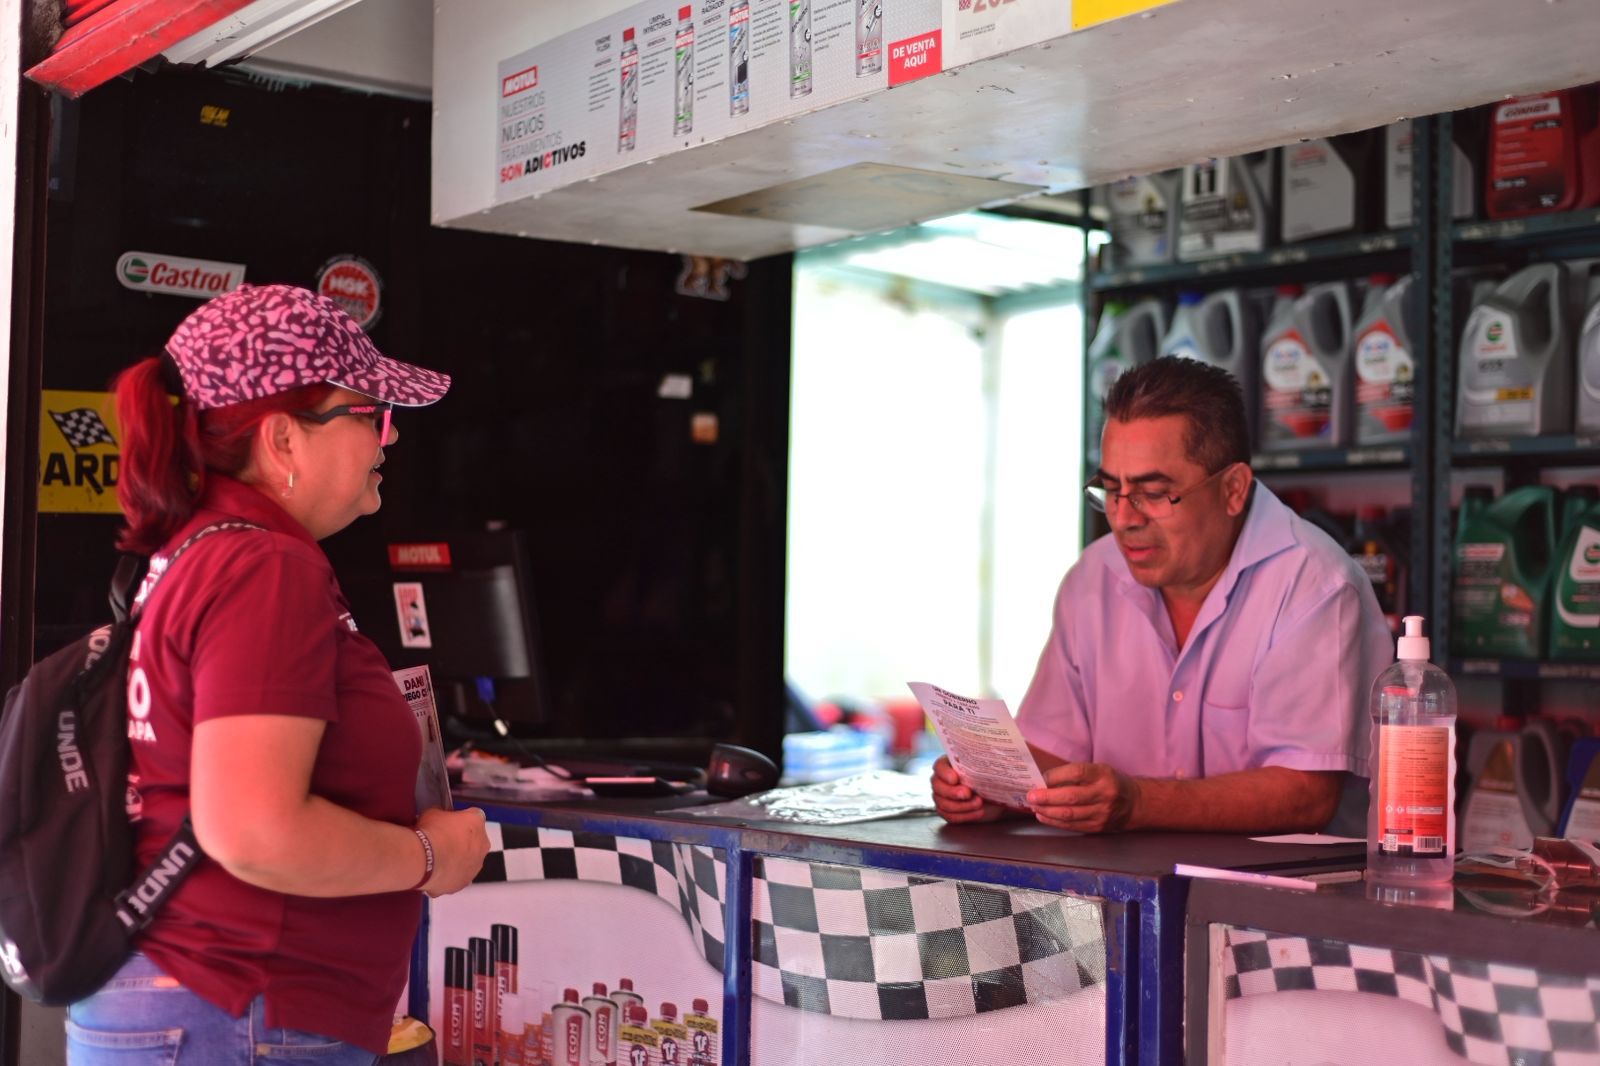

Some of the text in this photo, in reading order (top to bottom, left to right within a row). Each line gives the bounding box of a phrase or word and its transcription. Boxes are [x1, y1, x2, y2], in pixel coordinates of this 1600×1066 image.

[893, 38, 936, 60] DE VENTA
[904, 50, 927, 69] AQUÍ
[502, 113, 545, 142] NUEVOS
[500, 140, 587, 183] SON ADICTIVOS
[150, 262, 233, 292] Castrol
[415, 830, 433, 872] morena
